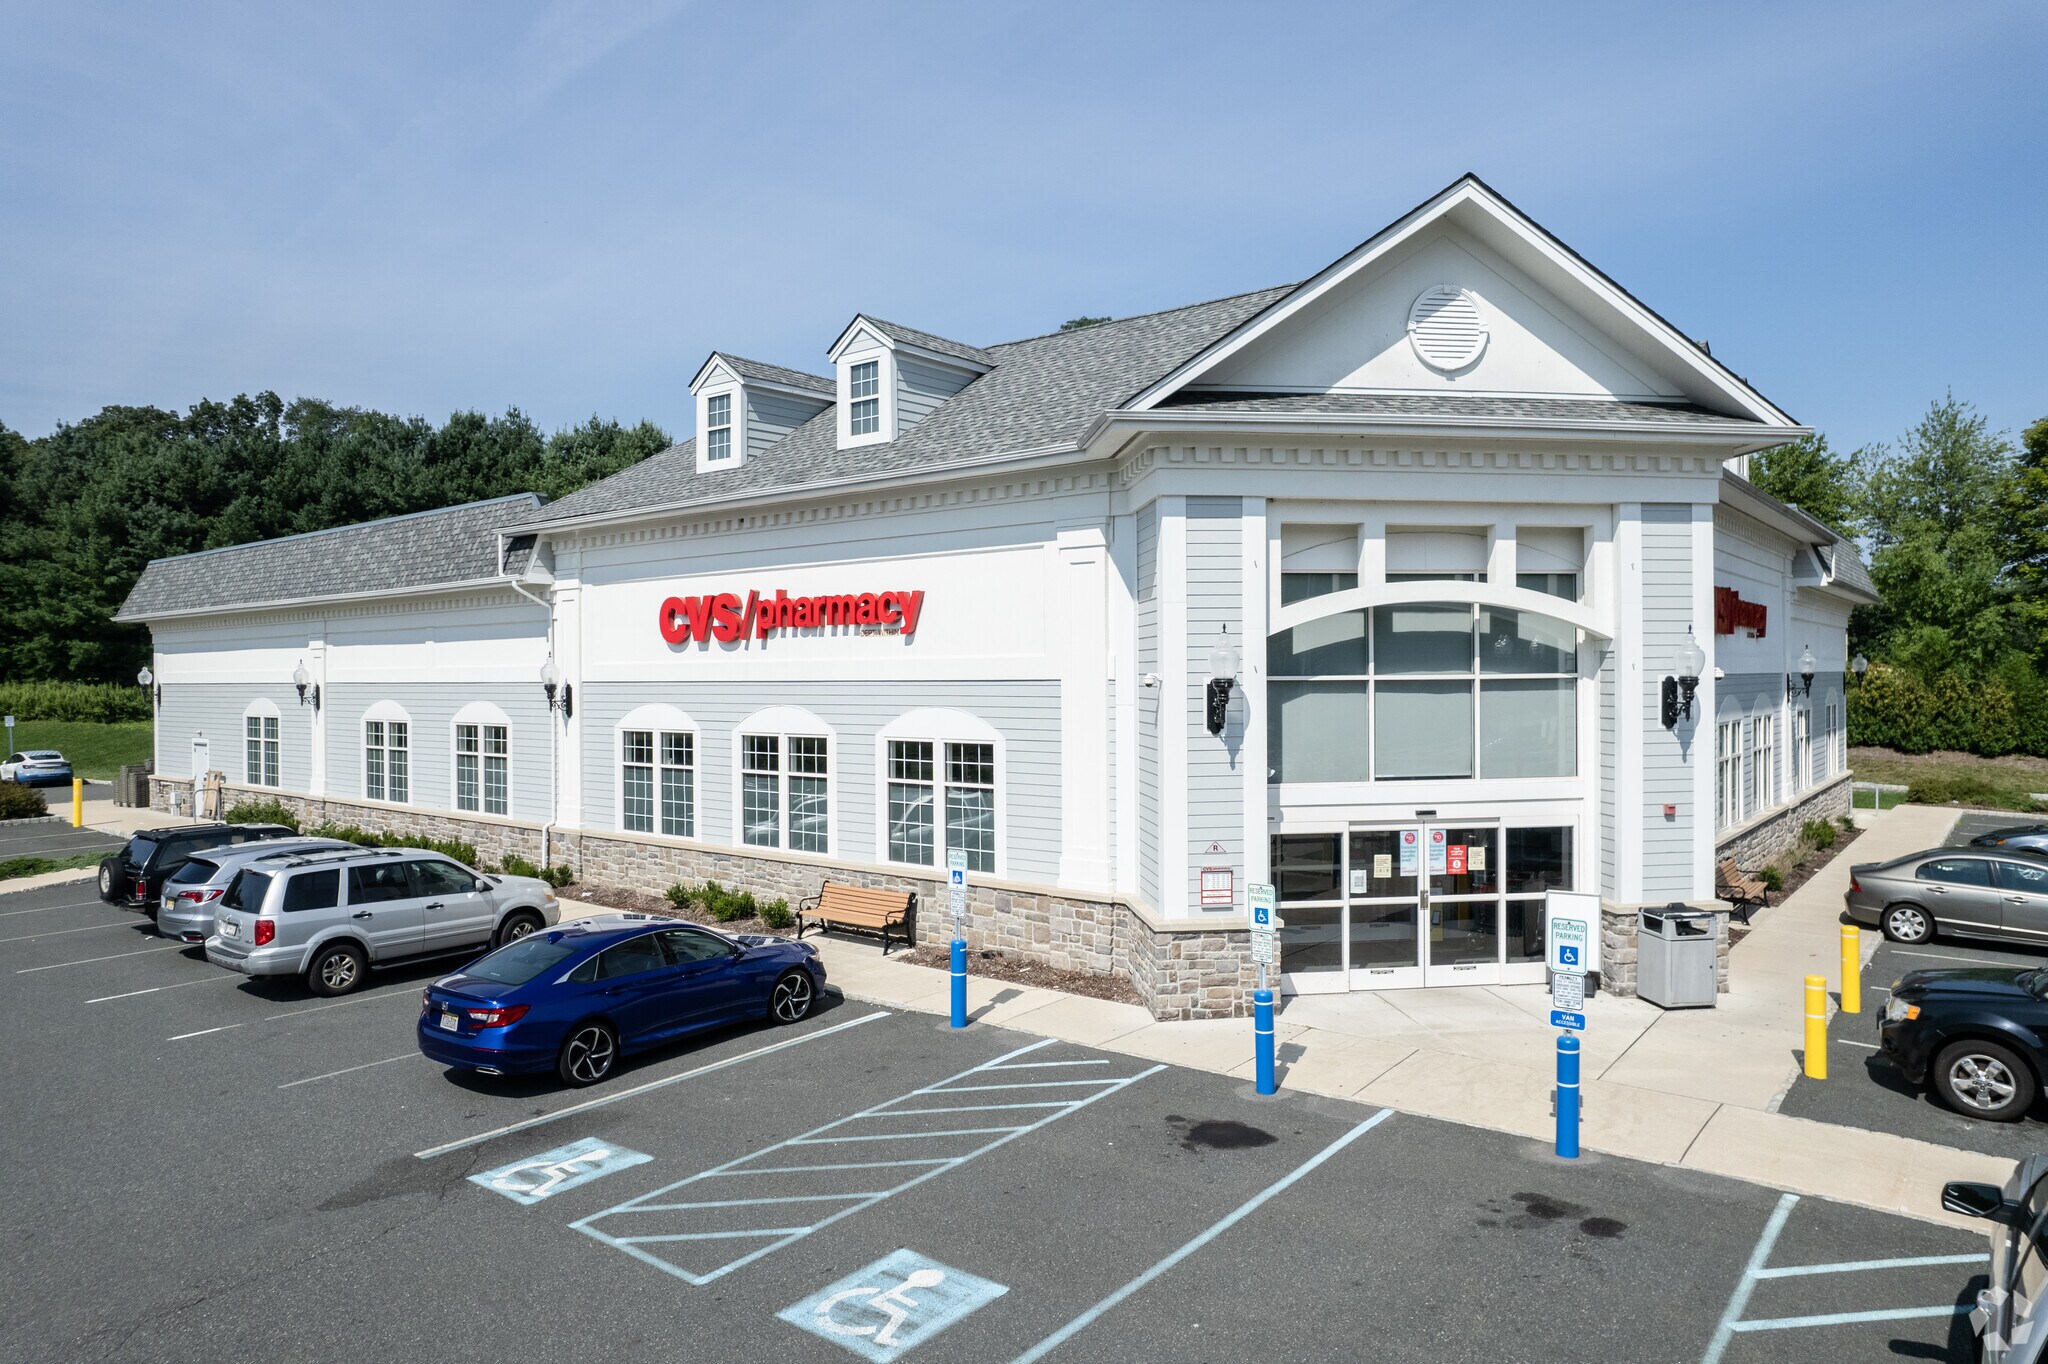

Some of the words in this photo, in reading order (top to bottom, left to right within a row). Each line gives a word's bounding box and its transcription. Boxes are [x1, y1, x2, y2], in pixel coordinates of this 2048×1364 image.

[659, 589, 925, 645] CVS/pharmacy
[1249, 887, 1273, 896] RESERVED
[1251, 895, 1271, 904] PARKING
[1553, 922, 1585, 933] RESERVED
[1555, 931, 1583, 942] PARKING
[1561, 1013, 1575, 1021] VAN
[1555, 1019, 1581, 1028] ACCESSIBLE
